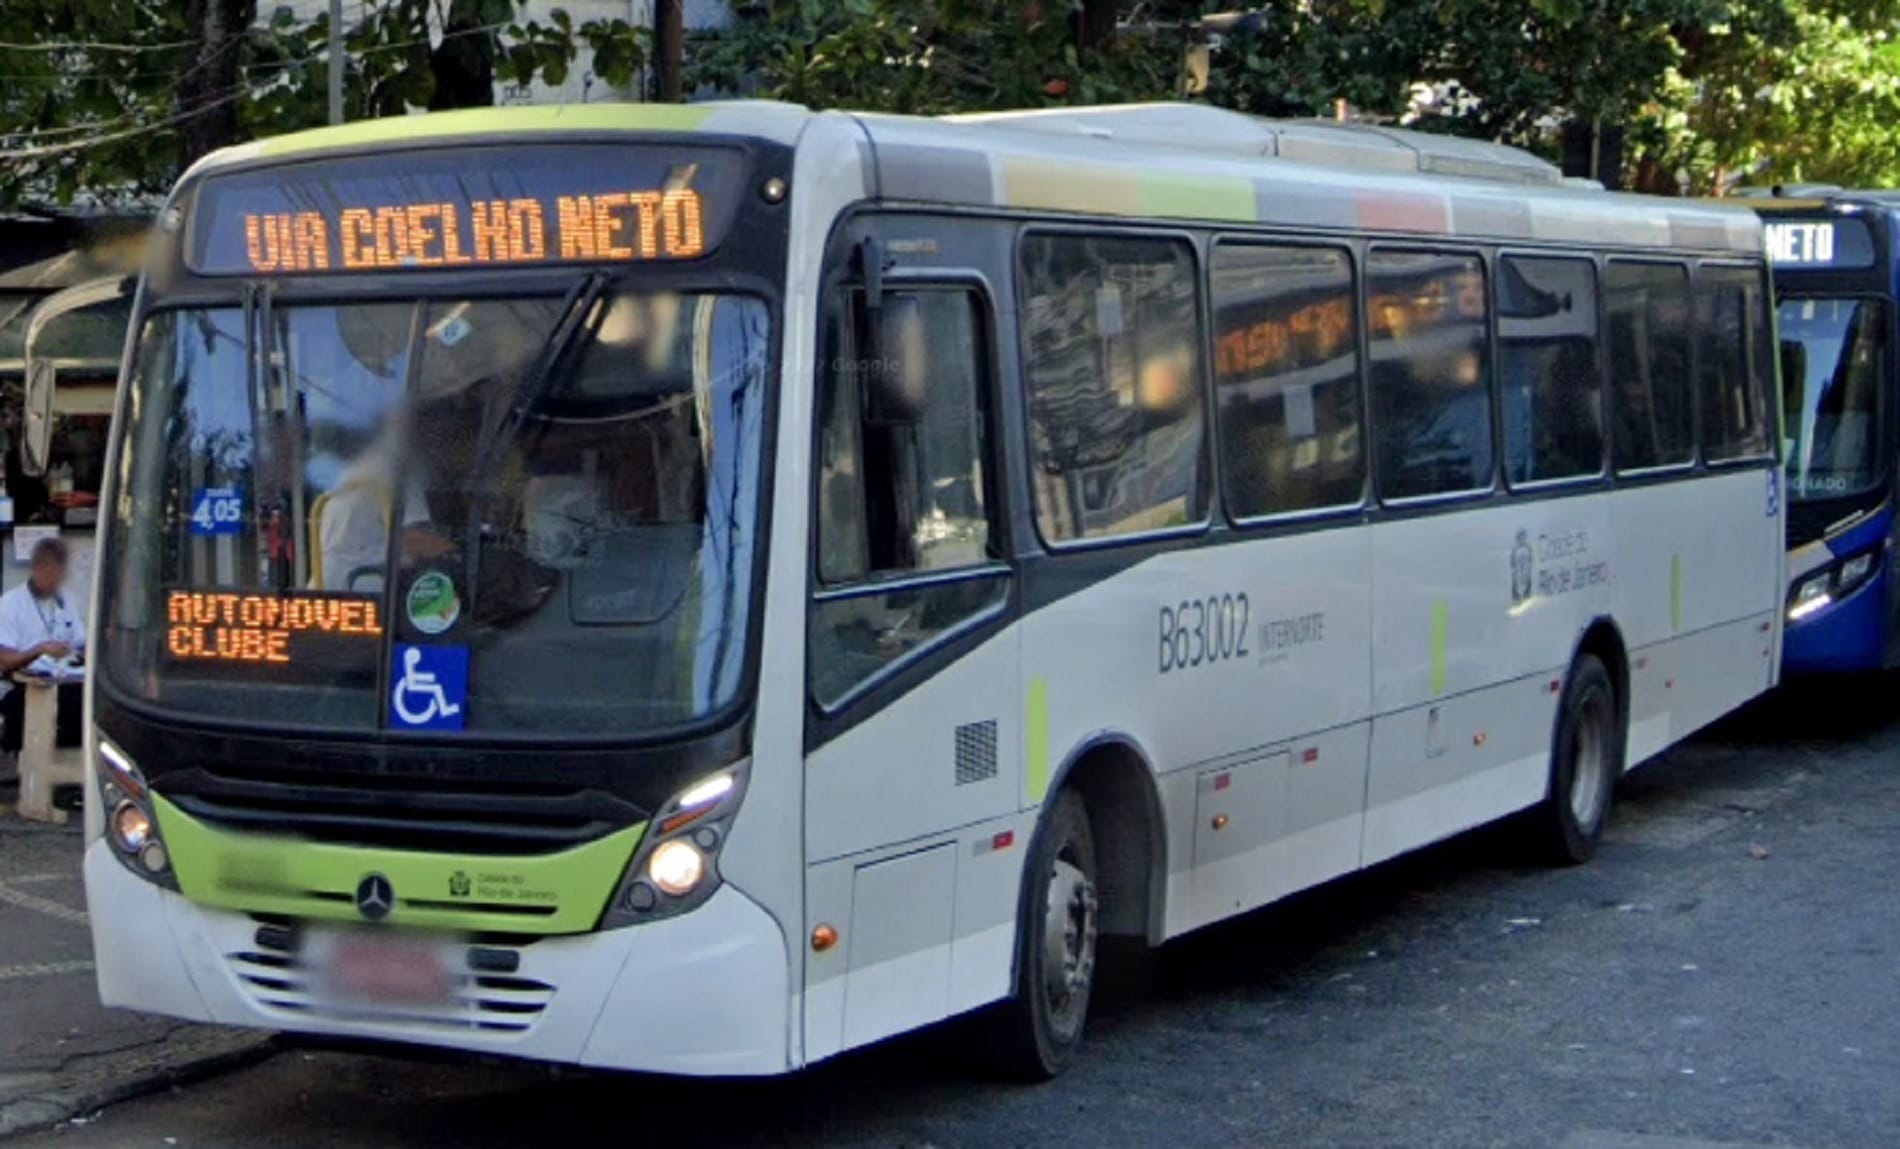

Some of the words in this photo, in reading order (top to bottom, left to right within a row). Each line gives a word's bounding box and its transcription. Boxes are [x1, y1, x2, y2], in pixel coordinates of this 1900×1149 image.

[245, 211, 329, 271] VIA
[340, 198, 545, 267] COELHO
[557, 189, 703, 260] NETO
[193, 498, 241, 530] 4,05
[168, 626, 290, 662] CLUBE
[1158, 591, 1249, 674] B63002
